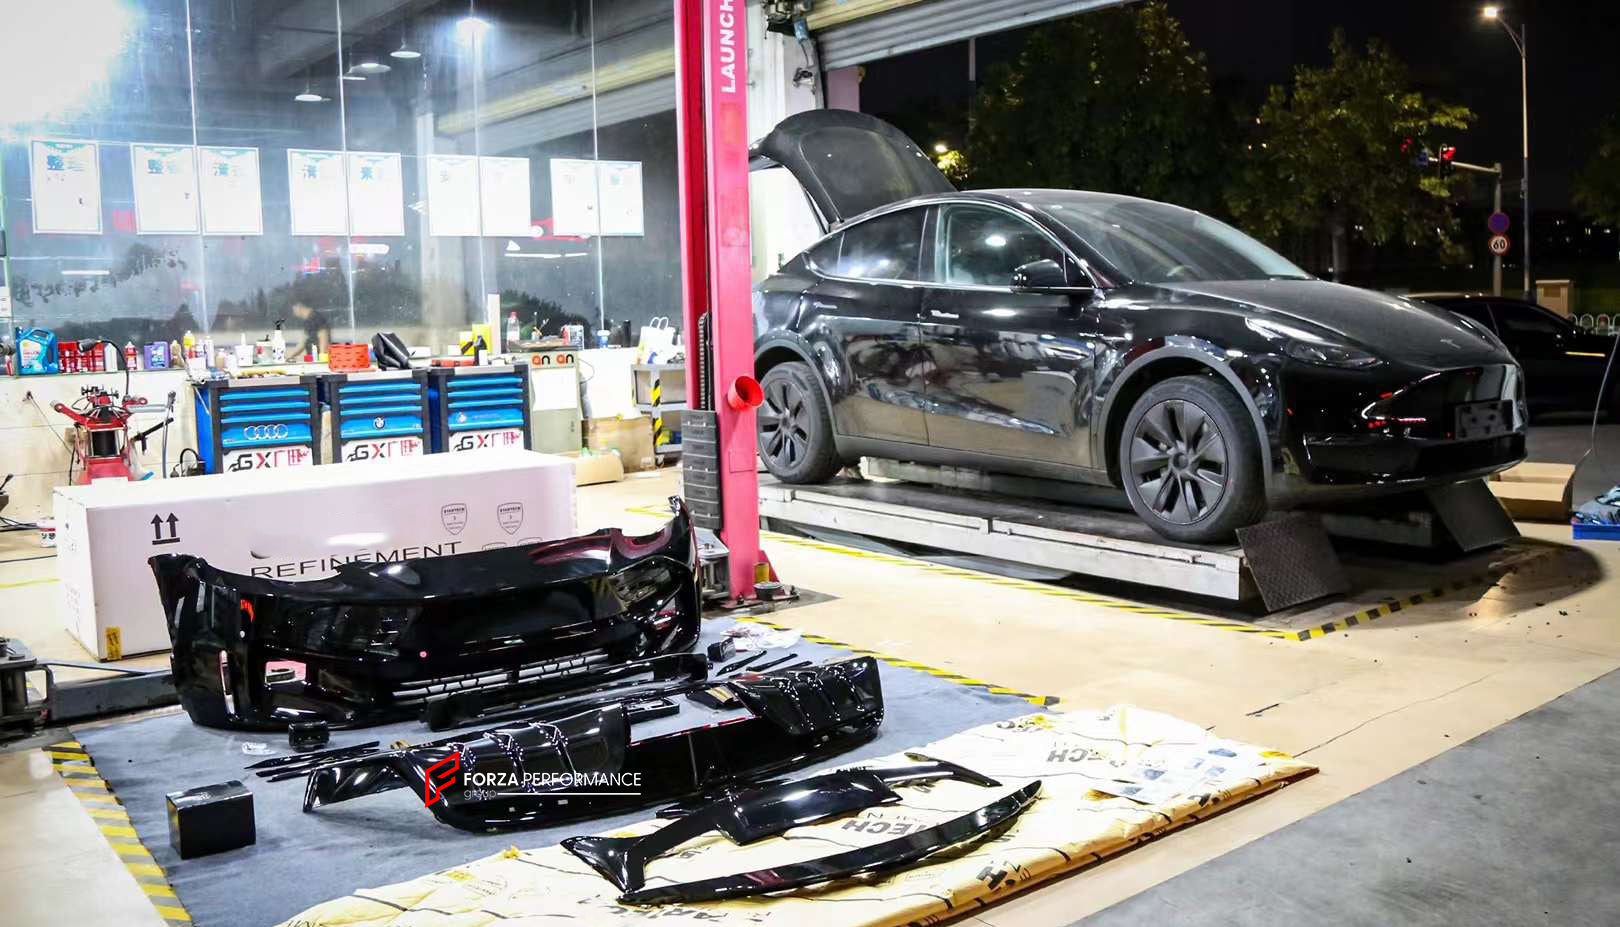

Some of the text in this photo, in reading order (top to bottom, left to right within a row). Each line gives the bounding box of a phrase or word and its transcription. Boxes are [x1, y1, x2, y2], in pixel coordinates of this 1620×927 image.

[720, 0, 736, 93] LAUNCH
[1493, 239, 1505, 249] 60
[251, 541, 462, 578] REFINEMENT
